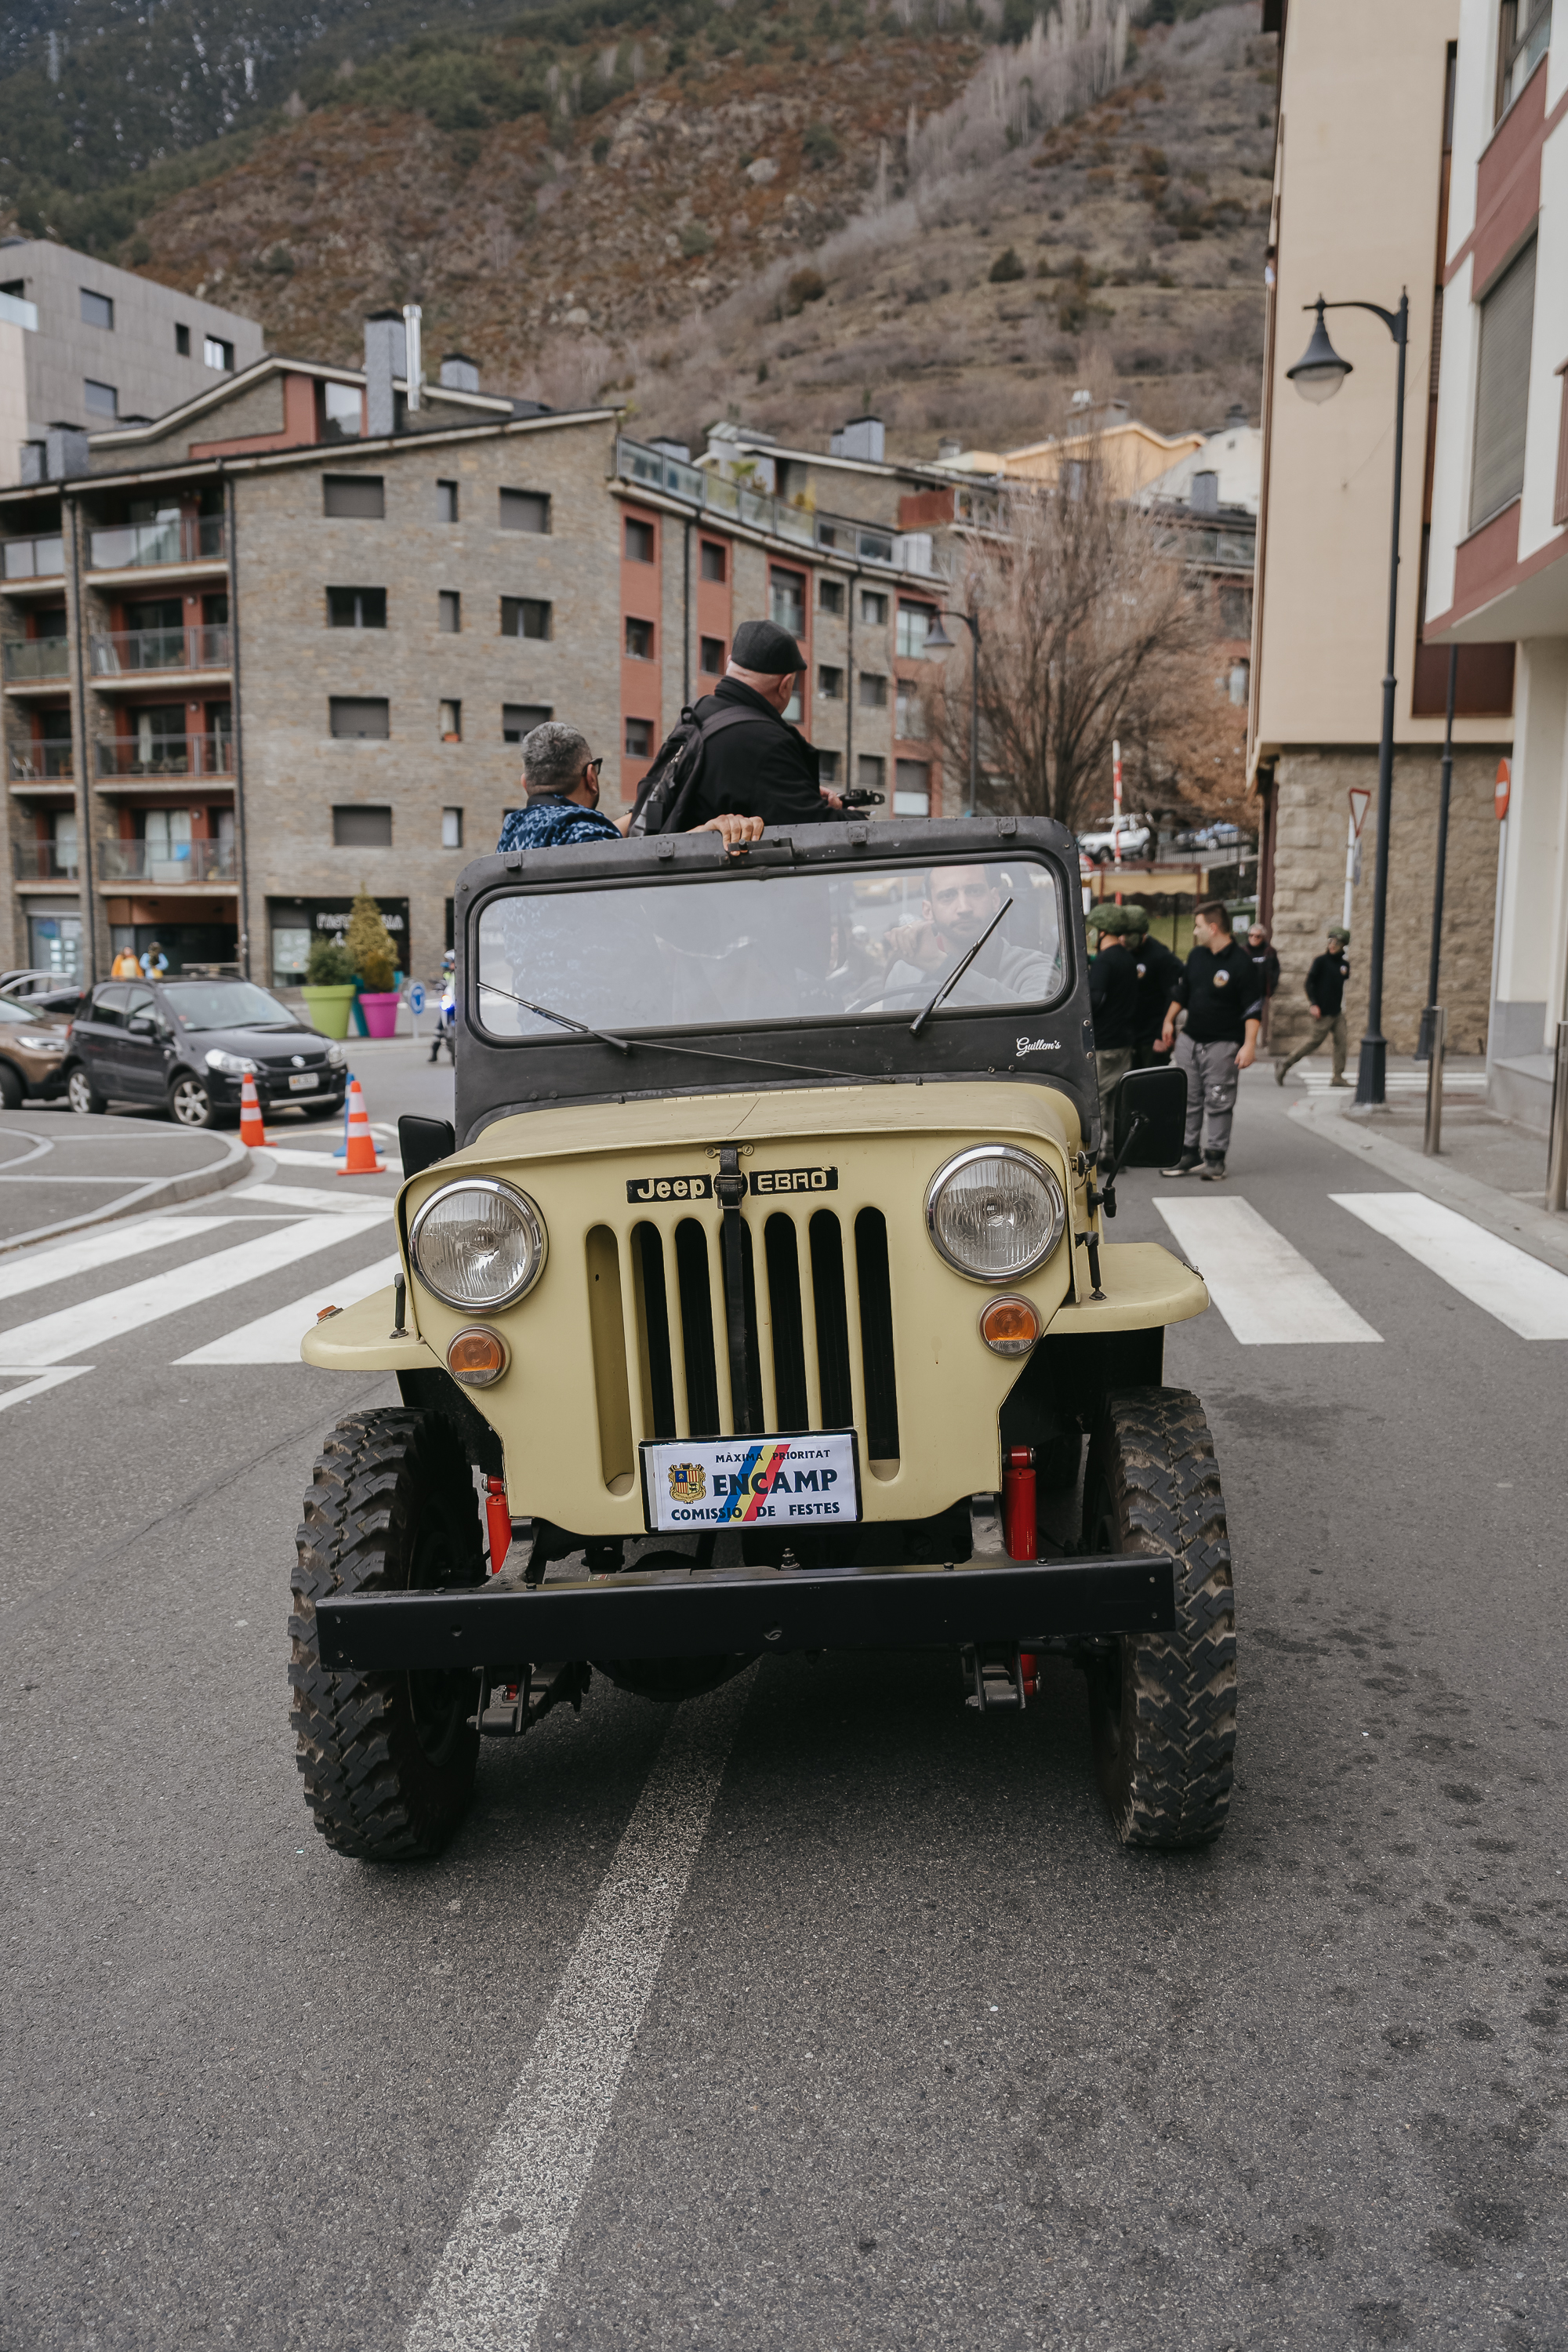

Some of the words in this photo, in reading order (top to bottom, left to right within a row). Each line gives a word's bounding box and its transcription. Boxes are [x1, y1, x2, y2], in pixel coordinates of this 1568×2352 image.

[1015, 1036, 1062, 1057] Guillem's
[637, 1178, 705, 1200] Jeep
[757, 1171, 827, 1192] EBRO
[715, 1451, 764, 1464] MÀXIMA
[772, 1449, 831, 1461] PRIORITAT
[712, 1468, 838, 1497] ENCAMP
[670, 1504, 743, 1521] COMISSIÓ
[756, 1505, 776, 1518] DE
[789, 1501, 840, 1516] FESTES
